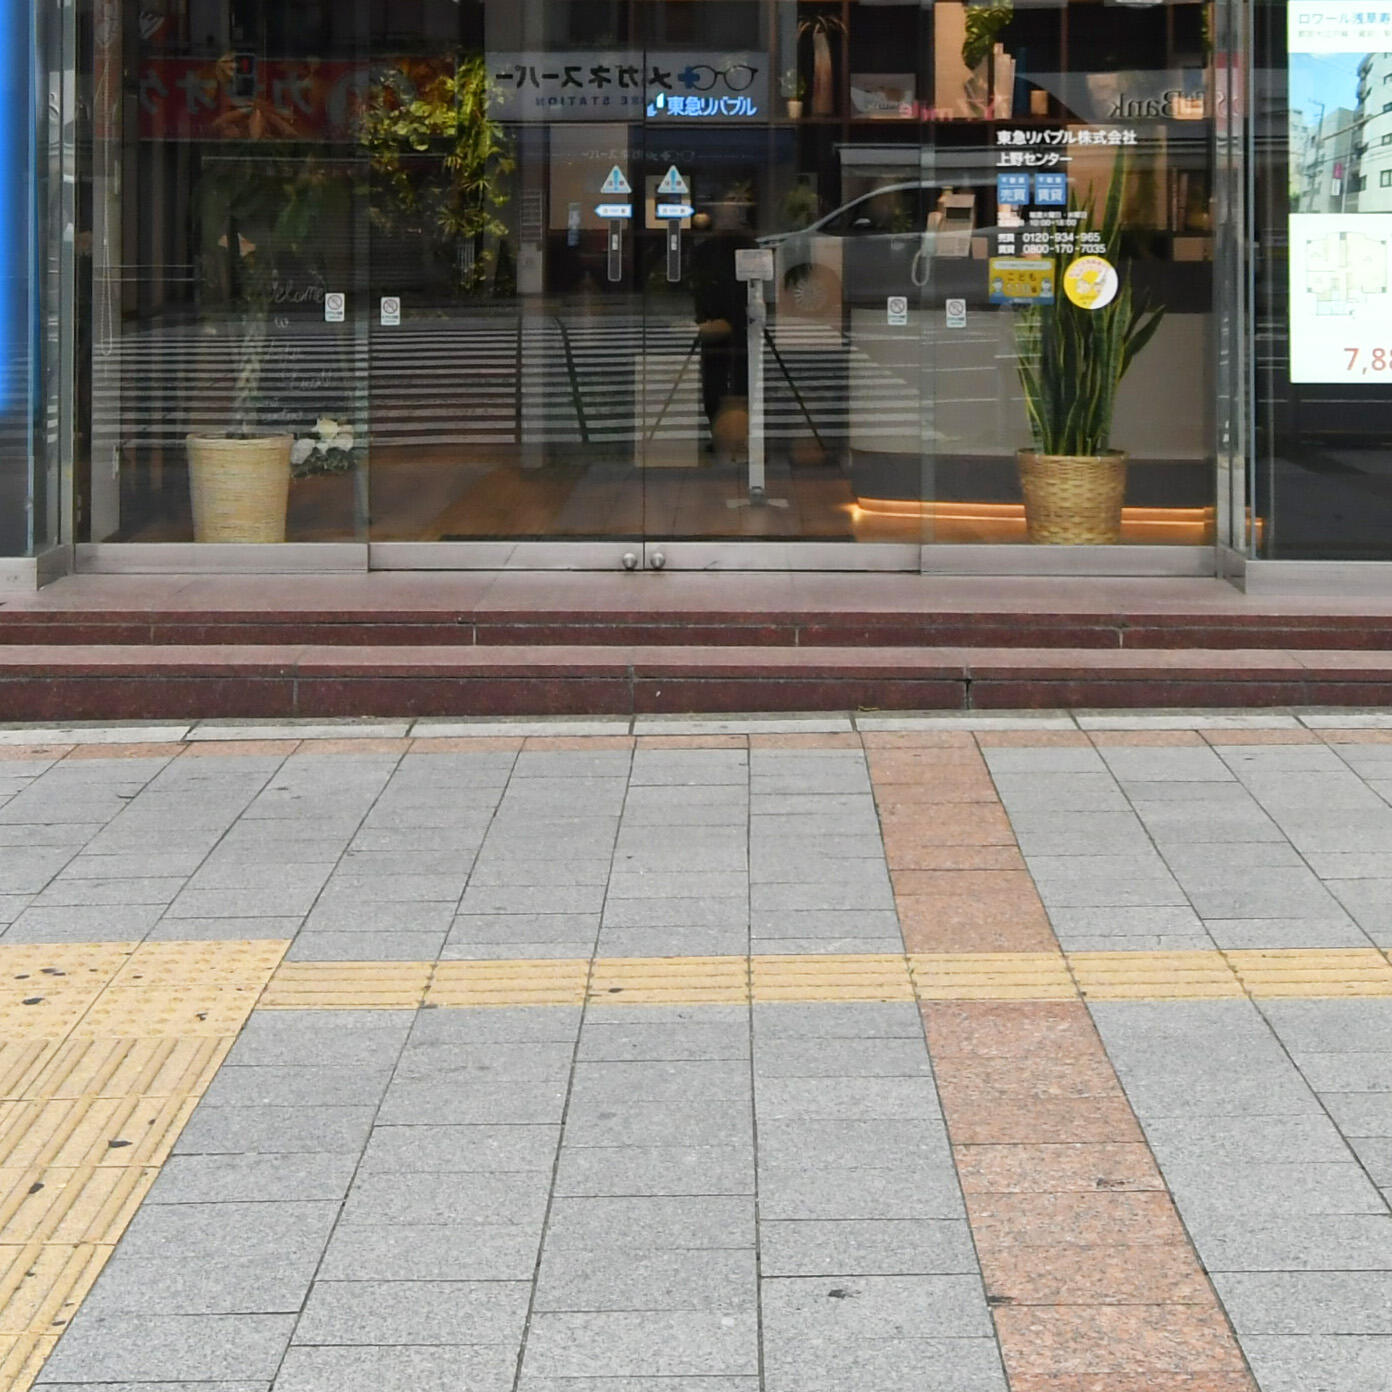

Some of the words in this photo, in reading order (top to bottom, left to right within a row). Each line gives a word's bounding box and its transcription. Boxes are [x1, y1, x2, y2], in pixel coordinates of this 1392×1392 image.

[667, 96, 757, 116] 東急リバブル
[996, 129, 1138, 146] 東急リバブル株式会社
[996, 151, 1073, 167] 上野センター
[1000, 188, 1026, 203] 売買
[1022, 232, 1101, 243] 0120-934-965
